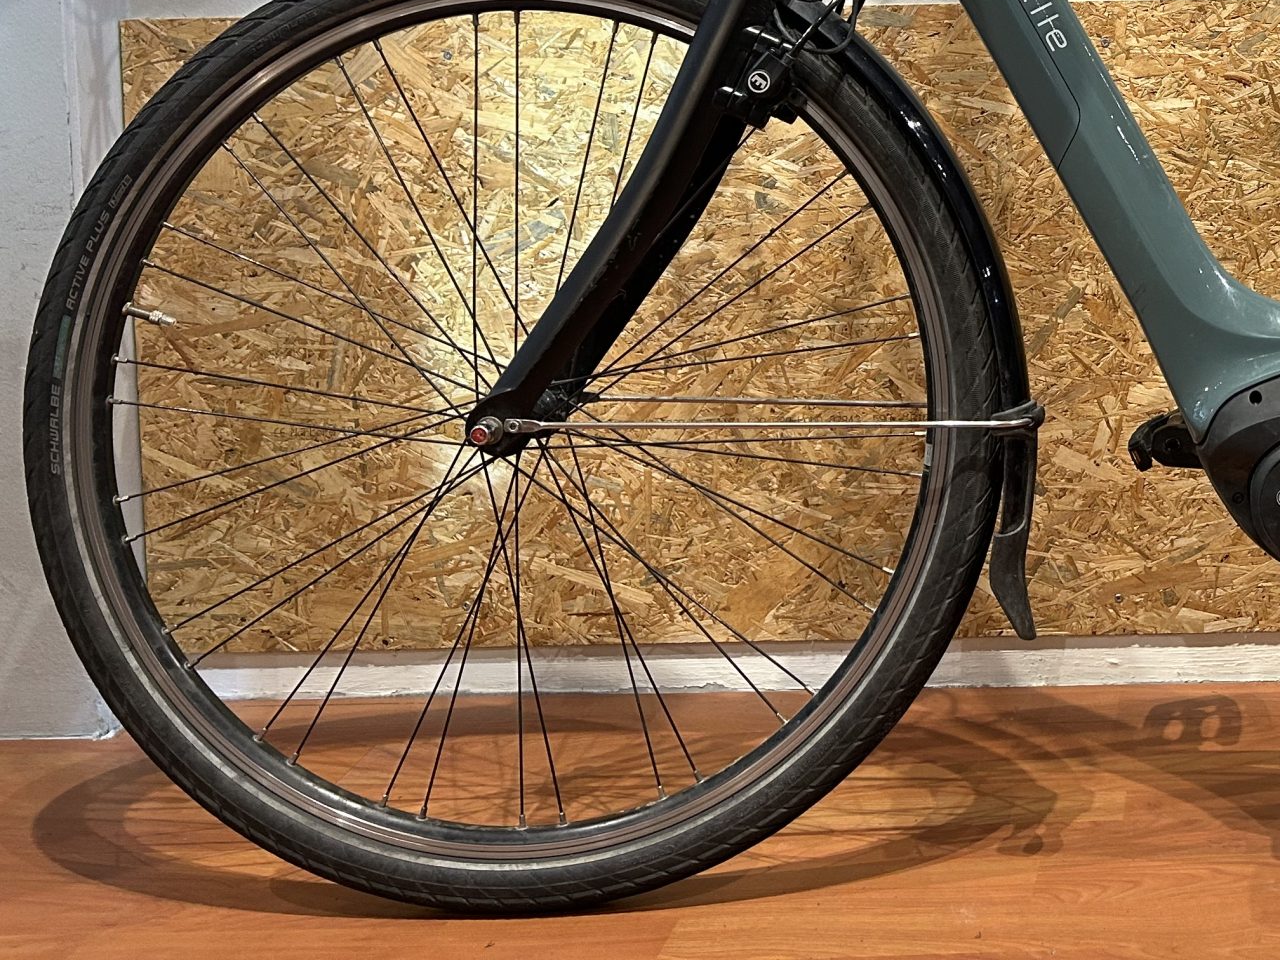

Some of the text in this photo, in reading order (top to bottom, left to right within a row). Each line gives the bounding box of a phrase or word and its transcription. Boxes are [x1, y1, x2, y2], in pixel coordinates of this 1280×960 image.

[66, 209, 110, 311] ACTIVE PLUS
[50, 384, 62, 475] SCHWALBE
